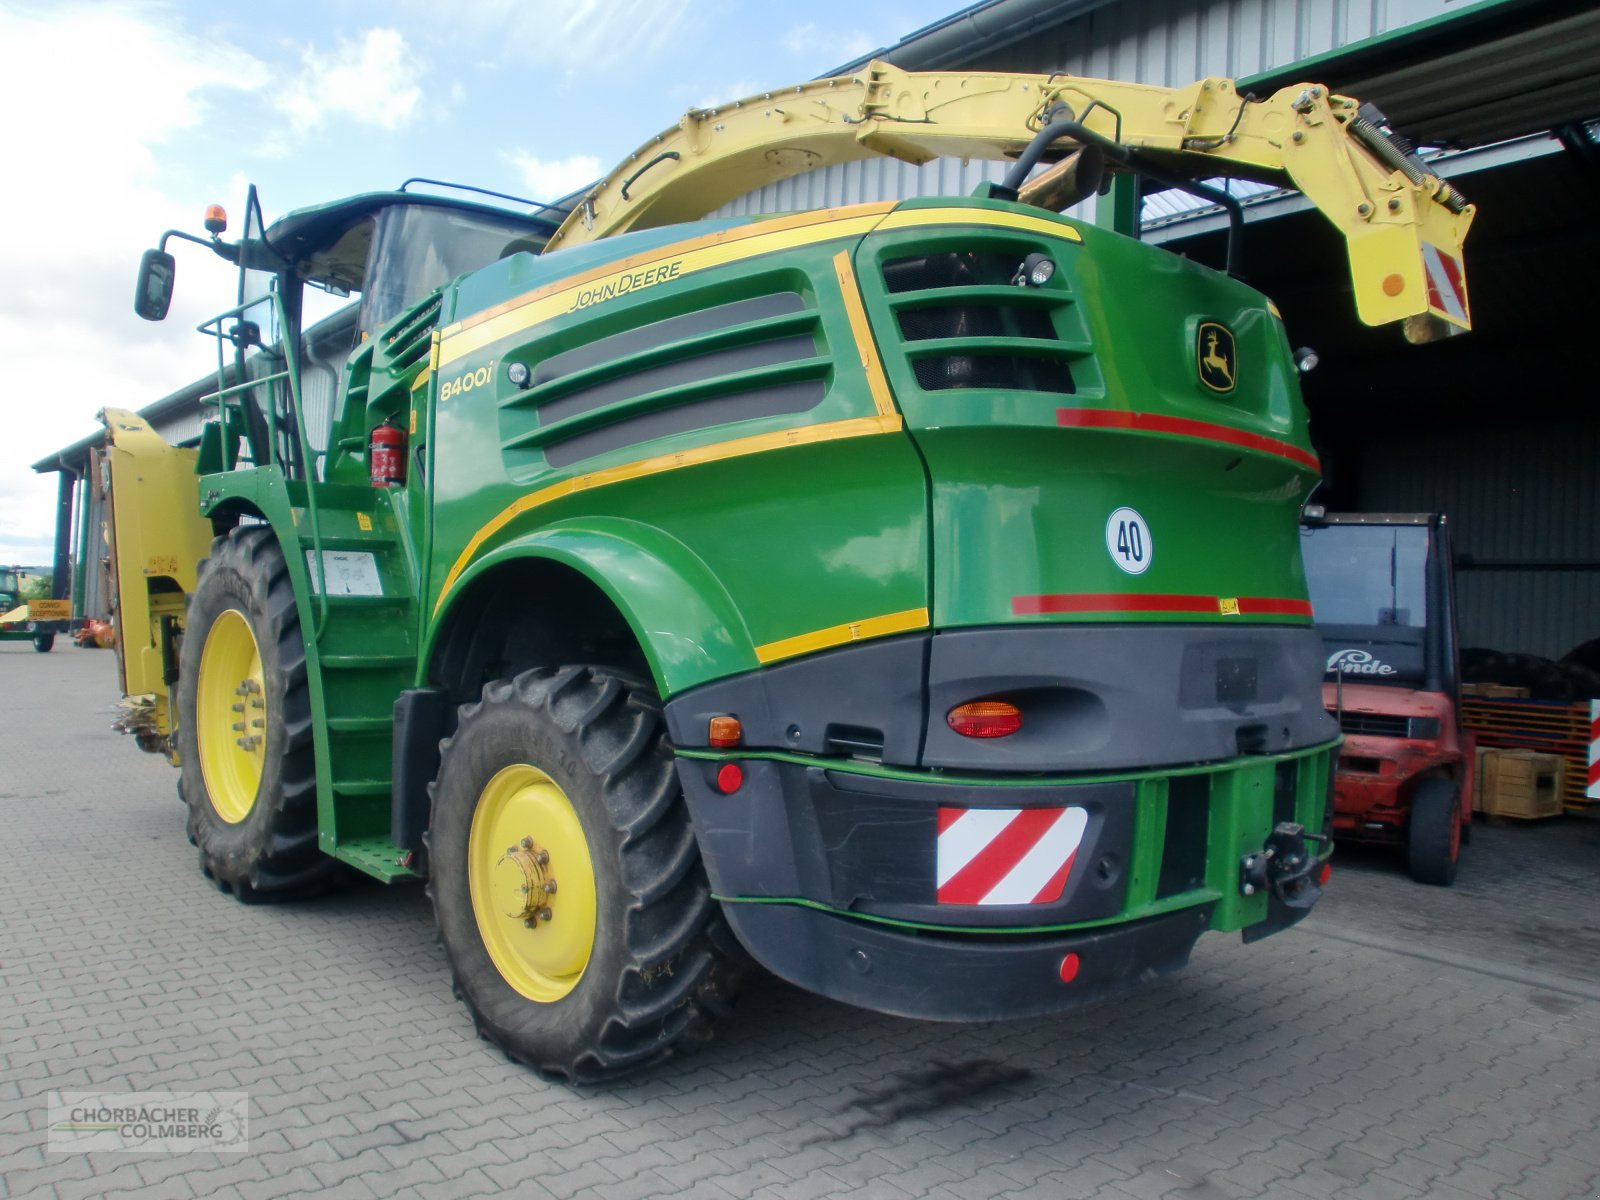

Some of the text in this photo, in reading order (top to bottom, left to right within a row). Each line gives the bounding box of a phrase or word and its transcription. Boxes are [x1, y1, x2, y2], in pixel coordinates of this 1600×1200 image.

[569, 260, 683, 311] JOHN DEERE
[440, 360, 494, 402] 8400i
[1117, 520, 1144, 562] 40
[1326, 648, 1398, 675] Linde
